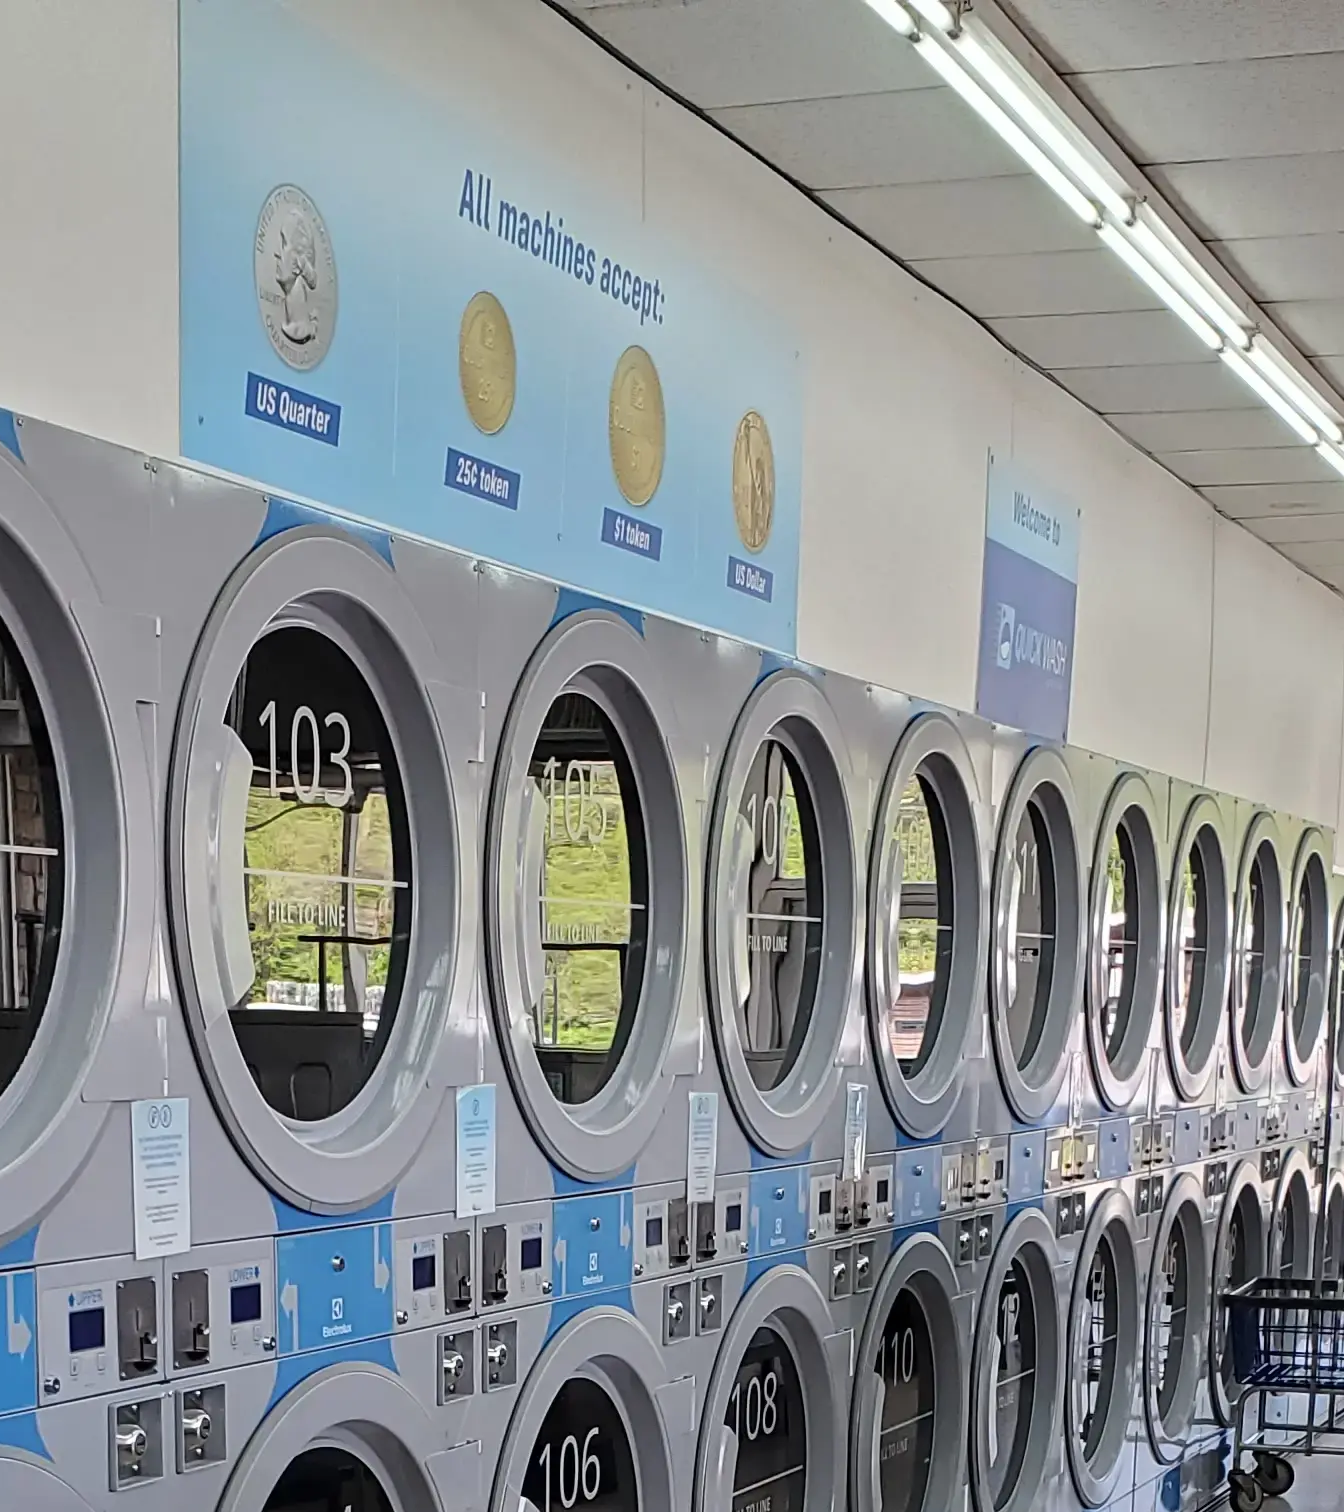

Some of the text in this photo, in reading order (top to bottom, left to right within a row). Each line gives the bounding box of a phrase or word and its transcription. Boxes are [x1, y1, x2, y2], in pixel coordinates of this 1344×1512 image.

[459, 169, 665, 326] All machines accept:
[256, 381, 331, 435] US Quarter
[456, 457, 510, 500] 25¢ token
[614, 515, 650, 551] $1 token
[1013, 490, 1061, 547] Welcome to
[735, 563, 766, 594] US Dollar
[259, 700, 355, 808] 103
[543, 756, 606, 844] 105
[268, 900, 346, 927] FILL TO LINE
[747, 934, 788, 953] FILL TO LINE
[76, 1288, 103, 1305] UPPER
[228, 1267, 254, 1283] LOWER
[322, 1323, 353, 1338] Electrolux
[878, 1327, 914, 1387] 110
[731, 1371, 778, 1446] 108
